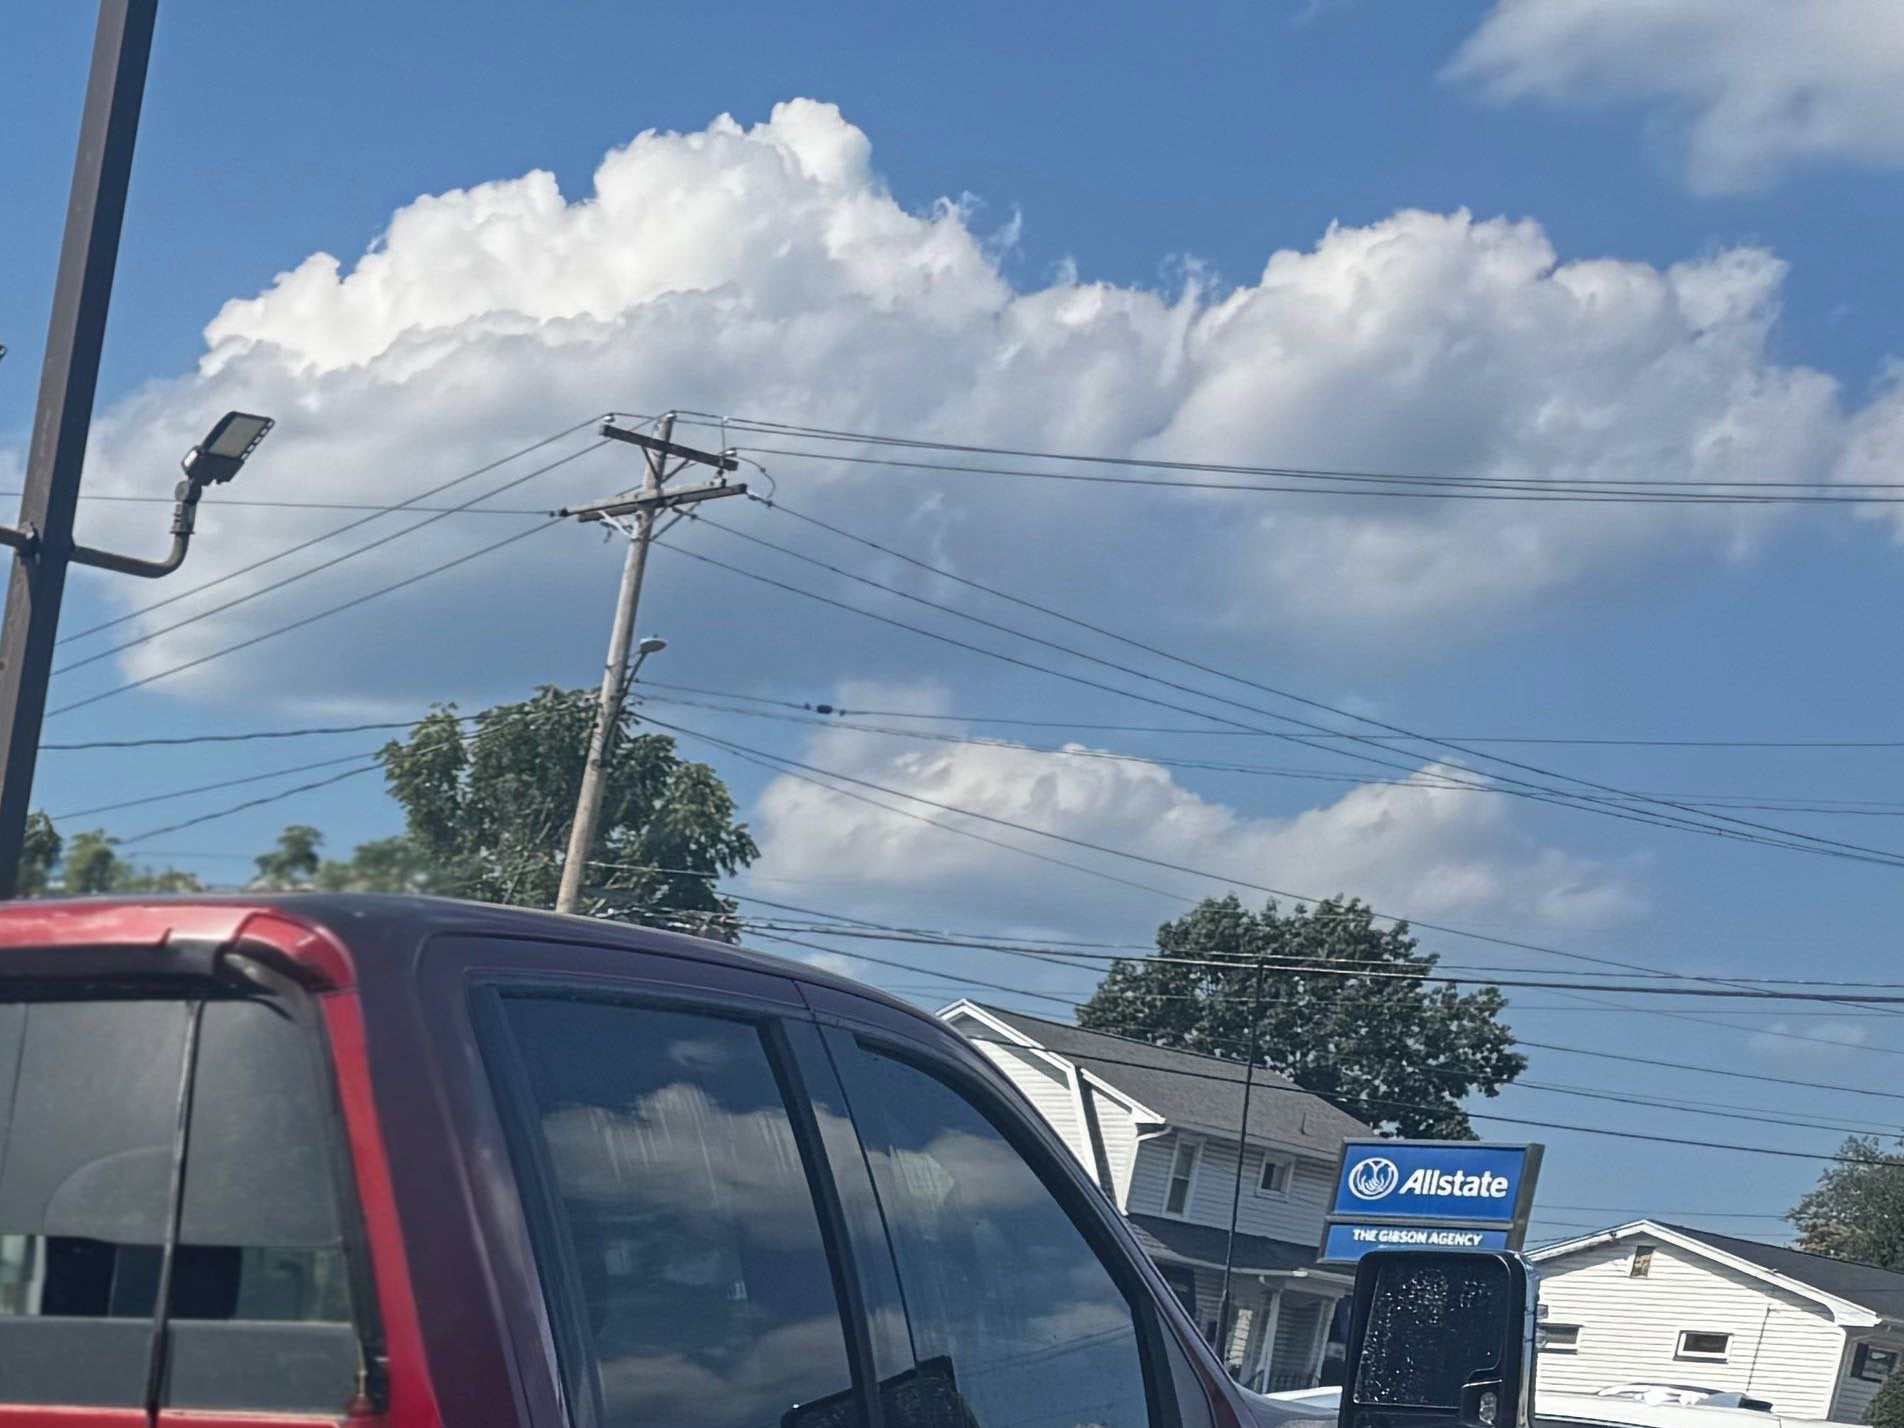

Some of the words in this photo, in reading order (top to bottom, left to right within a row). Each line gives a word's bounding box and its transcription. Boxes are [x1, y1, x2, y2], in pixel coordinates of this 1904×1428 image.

[1399, 1168, 1509, 1198] Allstate
[1352, 1228, 1377, 1243] THE
[1378, 1230, 1427, 1245] GIBSON
[1428, 1232, 1483, 1246] AGENCY
